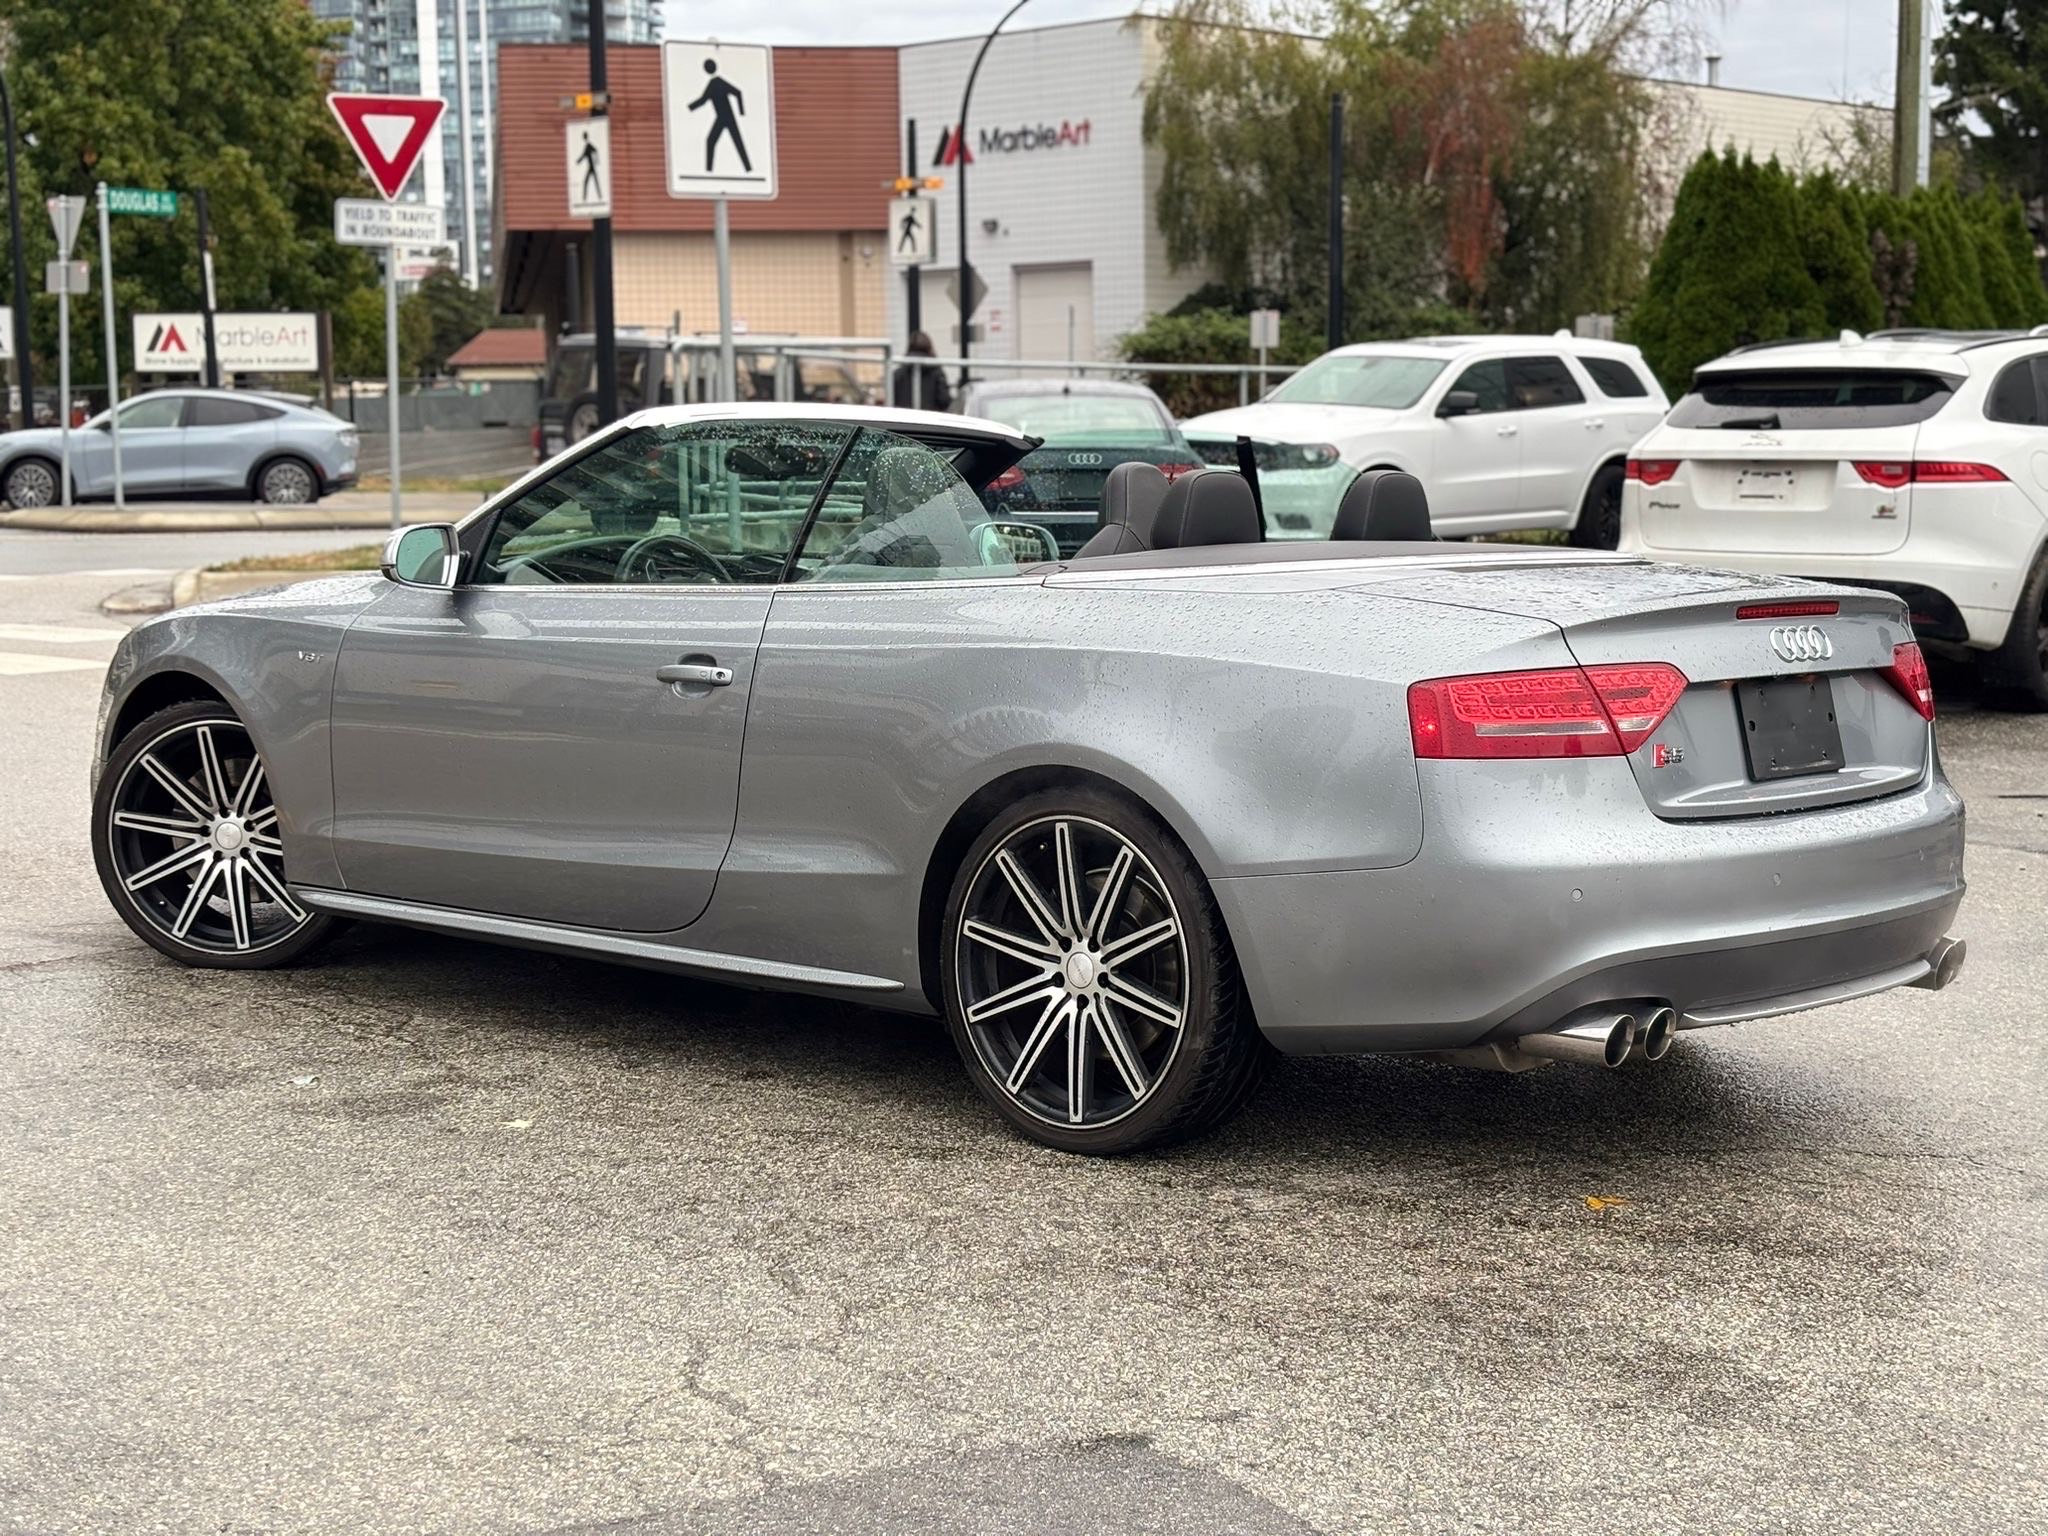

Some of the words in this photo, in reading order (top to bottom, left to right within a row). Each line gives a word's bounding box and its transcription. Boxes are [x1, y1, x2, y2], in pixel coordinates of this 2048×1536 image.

[979, 119, 1091, 153] MarbleArt
[109, 190, 159, 213] DOUGLAS
[344, 207, 374, 220] YIELD
[380, 209, 392, 221] TO
[397, 210, 436, 223] TRAFFIC
[346, 225, 357, 235] IN
[363, 225, 436, 239] ROUNDABOUT
